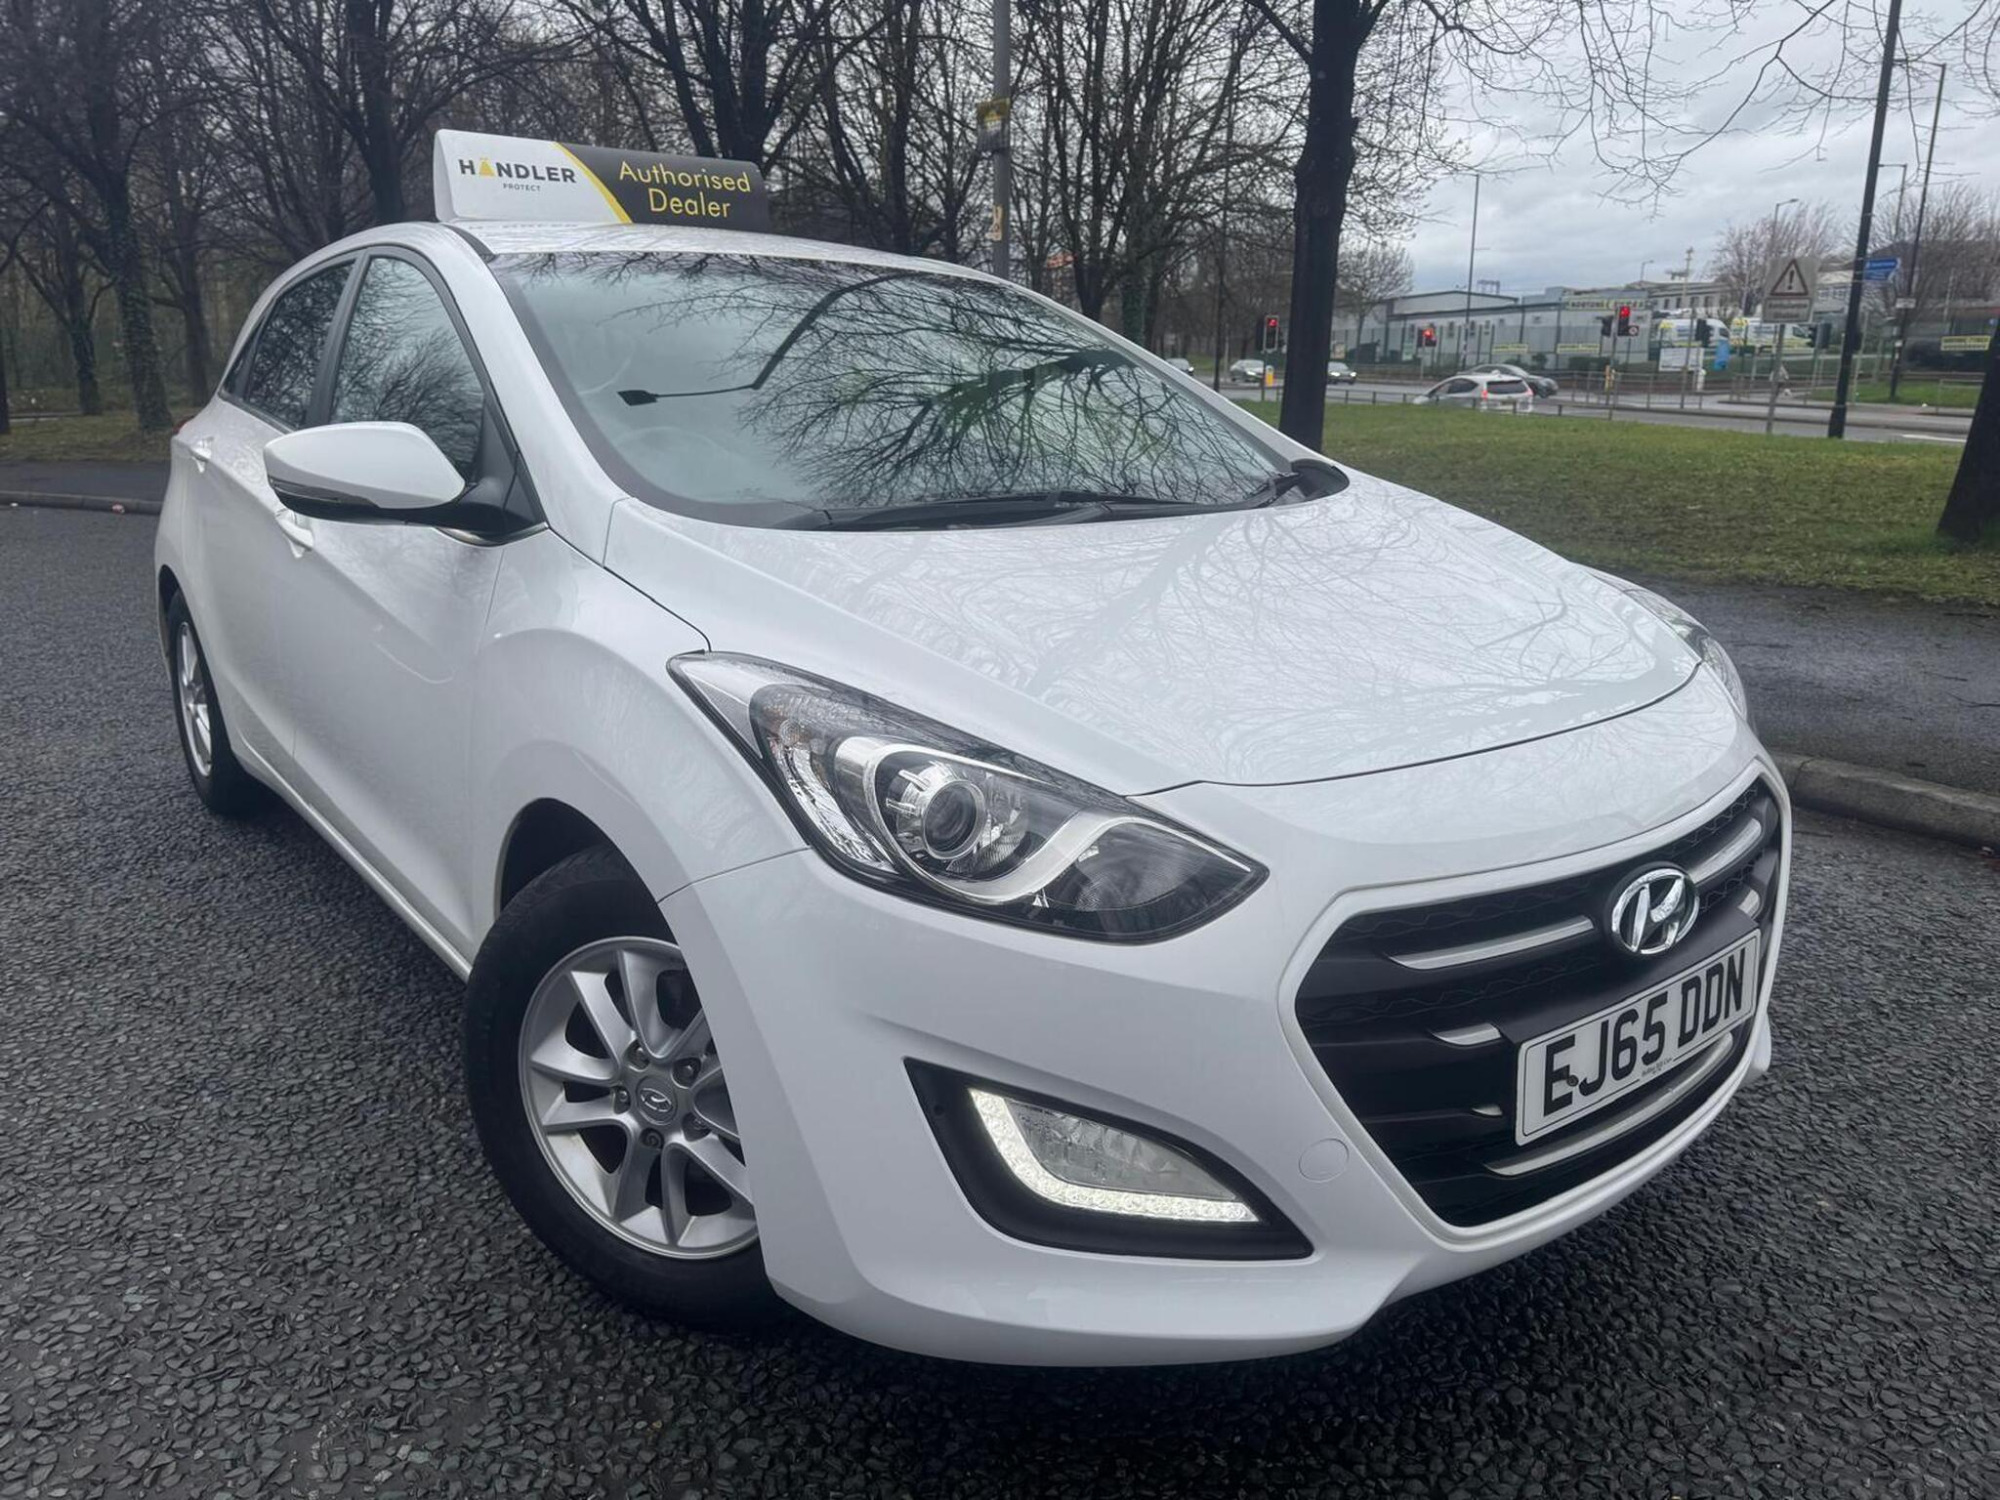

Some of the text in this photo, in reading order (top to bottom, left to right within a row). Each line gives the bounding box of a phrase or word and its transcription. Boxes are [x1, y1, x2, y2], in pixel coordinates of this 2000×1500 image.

[503, 182, 541, 192] PROTECT
[619, 160, 751, 193] Authorised
[648, 187, 731, 218] Dealer
[1544, 948, 1745, 1117] EJ65 DDN
